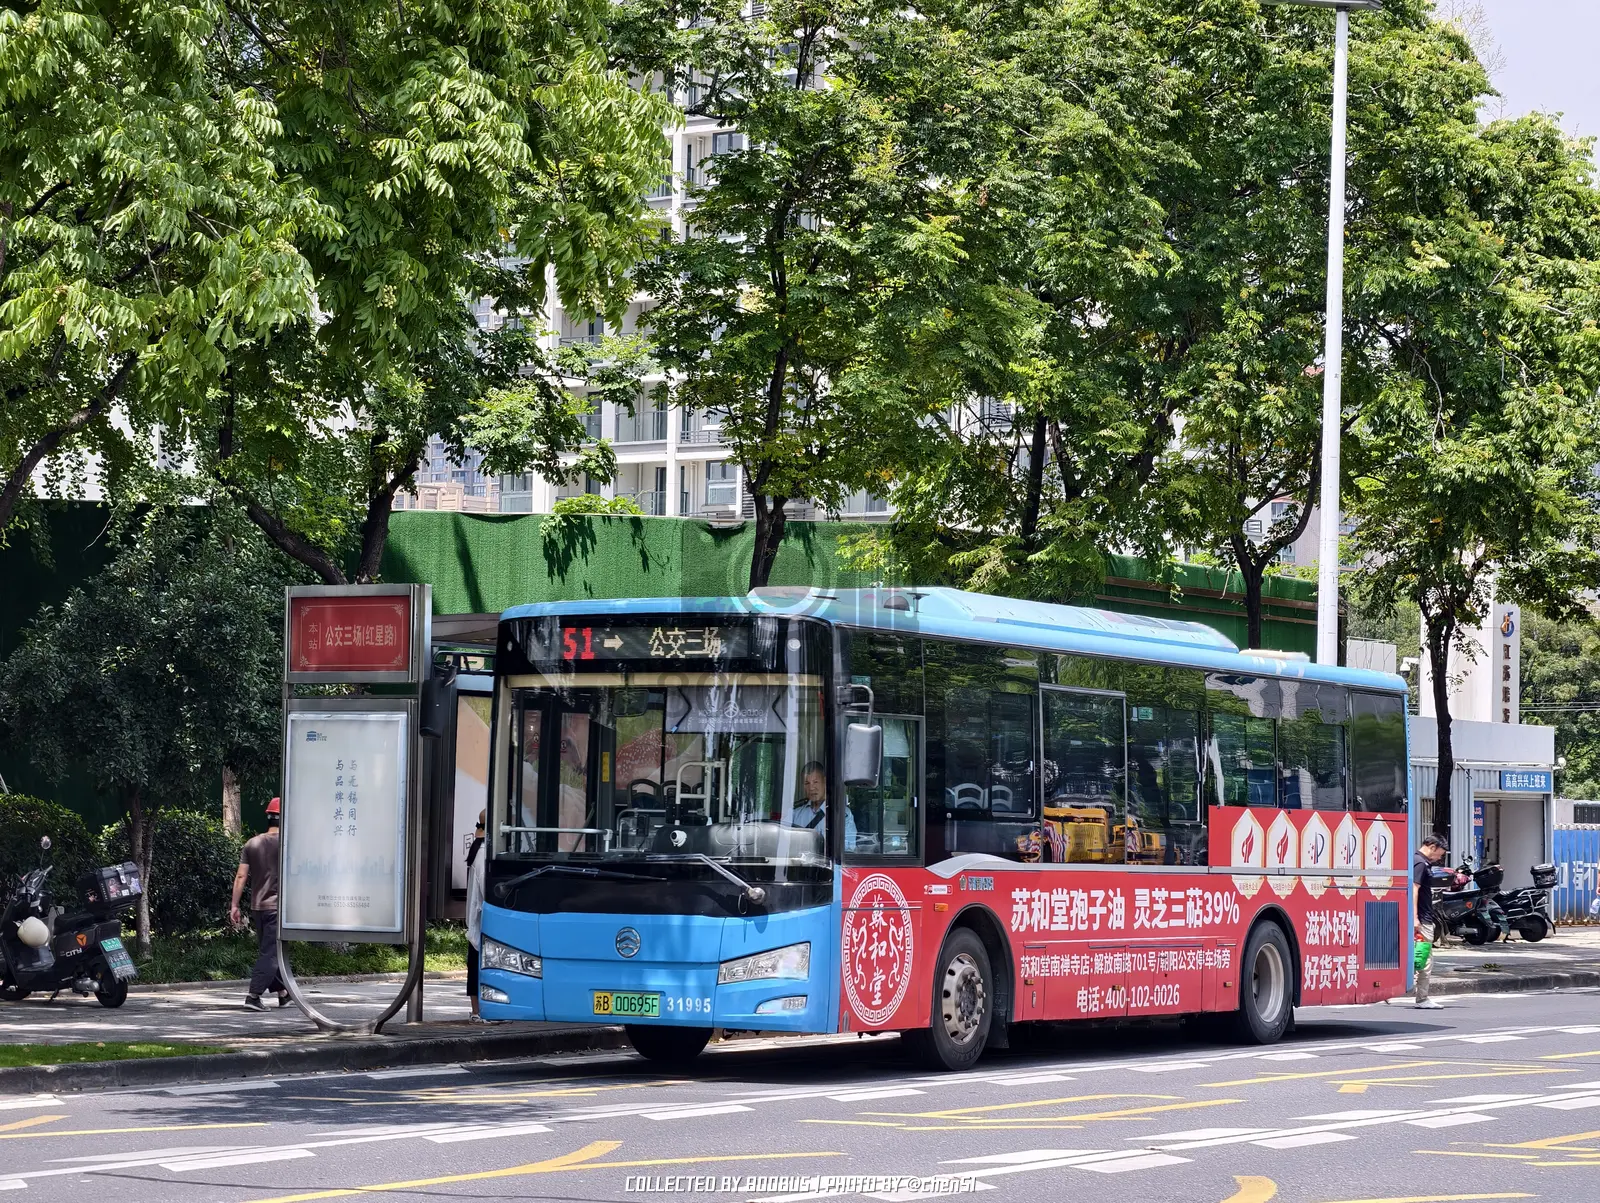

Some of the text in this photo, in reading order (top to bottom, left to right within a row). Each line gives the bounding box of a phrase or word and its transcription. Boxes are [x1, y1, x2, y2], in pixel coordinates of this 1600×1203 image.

[308, 622, 319, 650] 本站
[325, 624, 397, 647] 公交三场(红星路)
[562, 627, 595, 660] 51
[648, 626, 722, 659] 公交三场
[333, 758, 345, 837] 与品牌共兴
[347, 759, 359, 837] 与无锡同行
[1010, 886, 1240, 932] 苏和堂孢子油 灵芝三萜39%
[1305, 909, 1360, 946] 滋补好物
[65, 947, 83, 958] CITY
[1303, 953, 1360, 991] 好货不贵
[615, 996, 658, 1013] 00695F
[667, 996, 712, 1013] 31995
[1076, 983, 1181, 1014] 电话:400-102-0026
